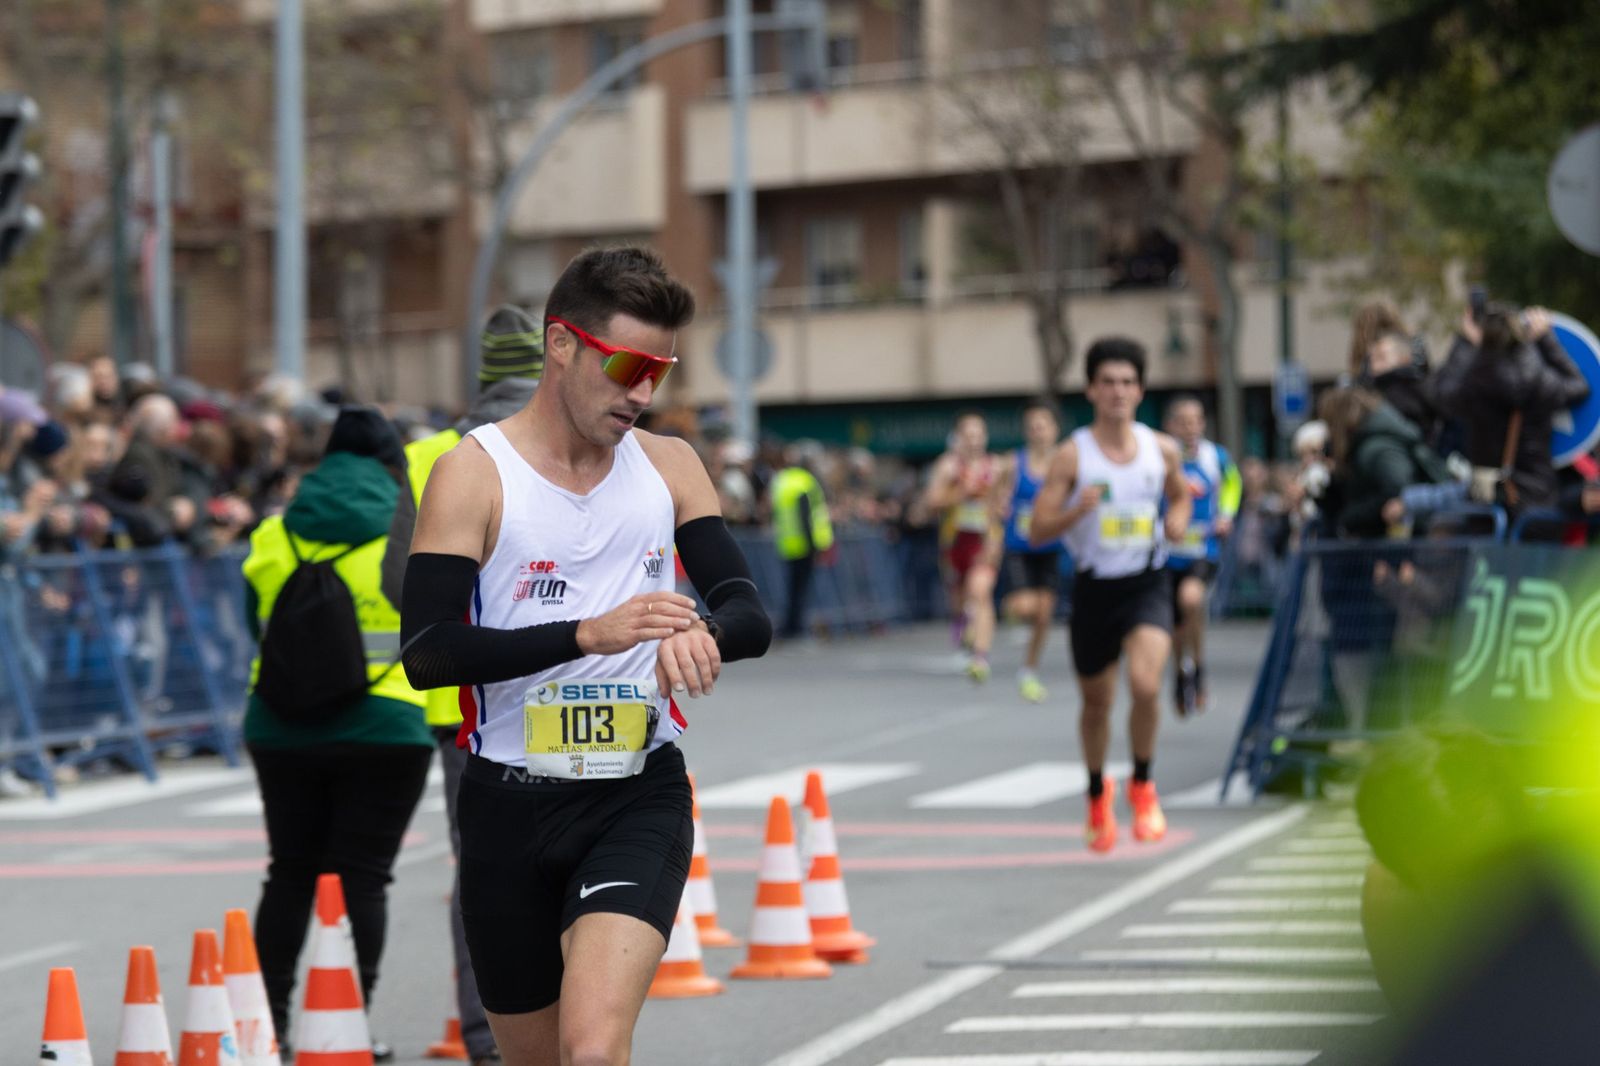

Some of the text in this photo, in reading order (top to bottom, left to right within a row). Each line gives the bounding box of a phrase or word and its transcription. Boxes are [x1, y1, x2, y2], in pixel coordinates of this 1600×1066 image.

[529, 560, 555, 574] cap
[561, 684, 647, 700] SETEL
[560, 705, 615, 745] 103
[588, 743, 628, 752] ANTONIA
[586, 760, 624, 768] Ayuntamiento
